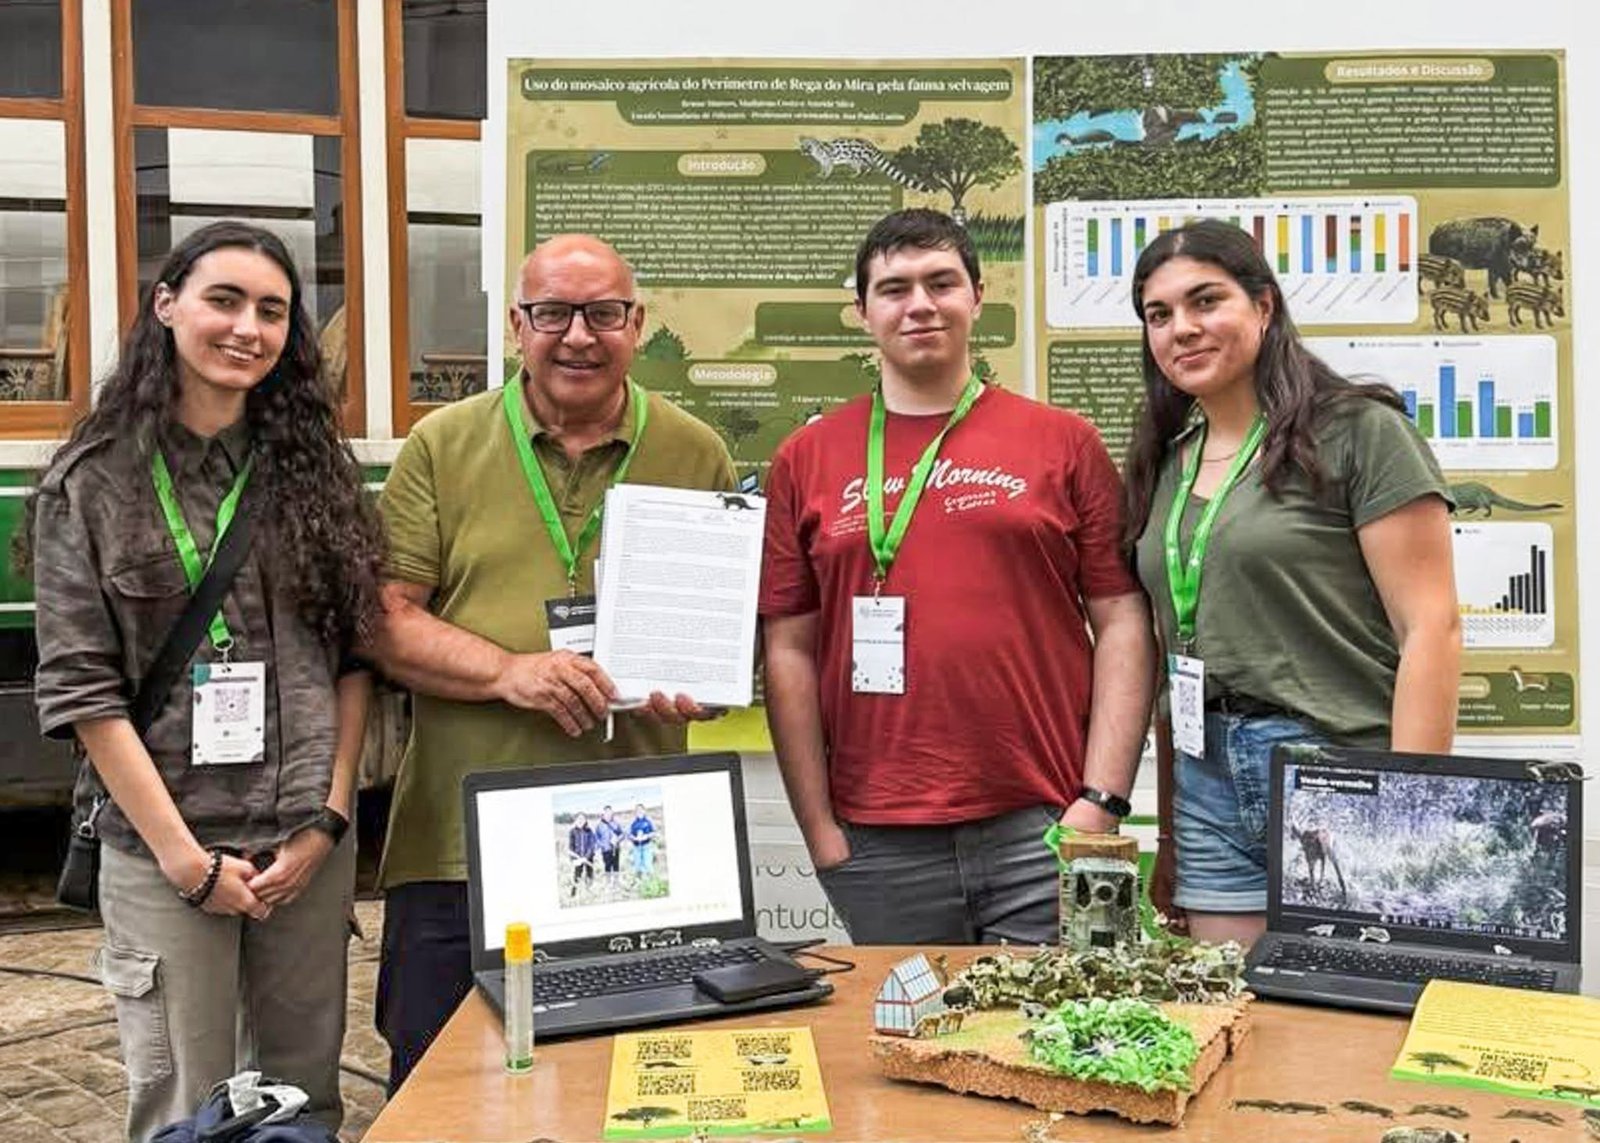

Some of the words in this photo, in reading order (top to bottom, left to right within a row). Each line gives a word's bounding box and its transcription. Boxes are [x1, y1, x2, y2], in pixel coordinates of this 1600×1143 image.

[1337, 65, 1408, 77] Resultados
[1421, 64, 1483, 76] Discussão
[524, 77, 548, 91] Uso
[550, 77, 568, 91] do
[570, 78, 625, 91] mosaico
[627, 77, 680, 93] agrícola
[682, 77, 700, 91] do
[772, 77, 788, 91] de
[789, 77, 822, 93] Rega
[824, 77, 842, 91] do
[843, 77, 874, 91] Mira
[876, 78, 905, 94] pela
[907, 78, 945, 91] fauna
[947, 78, 1010, 93] selvagem
[687, 157, 757, 172] Introdução
[694, 367, 773, 382] Metodologia
[840, 476, 905, 514] Slw
[912, 459, 1028, 499] Morning
